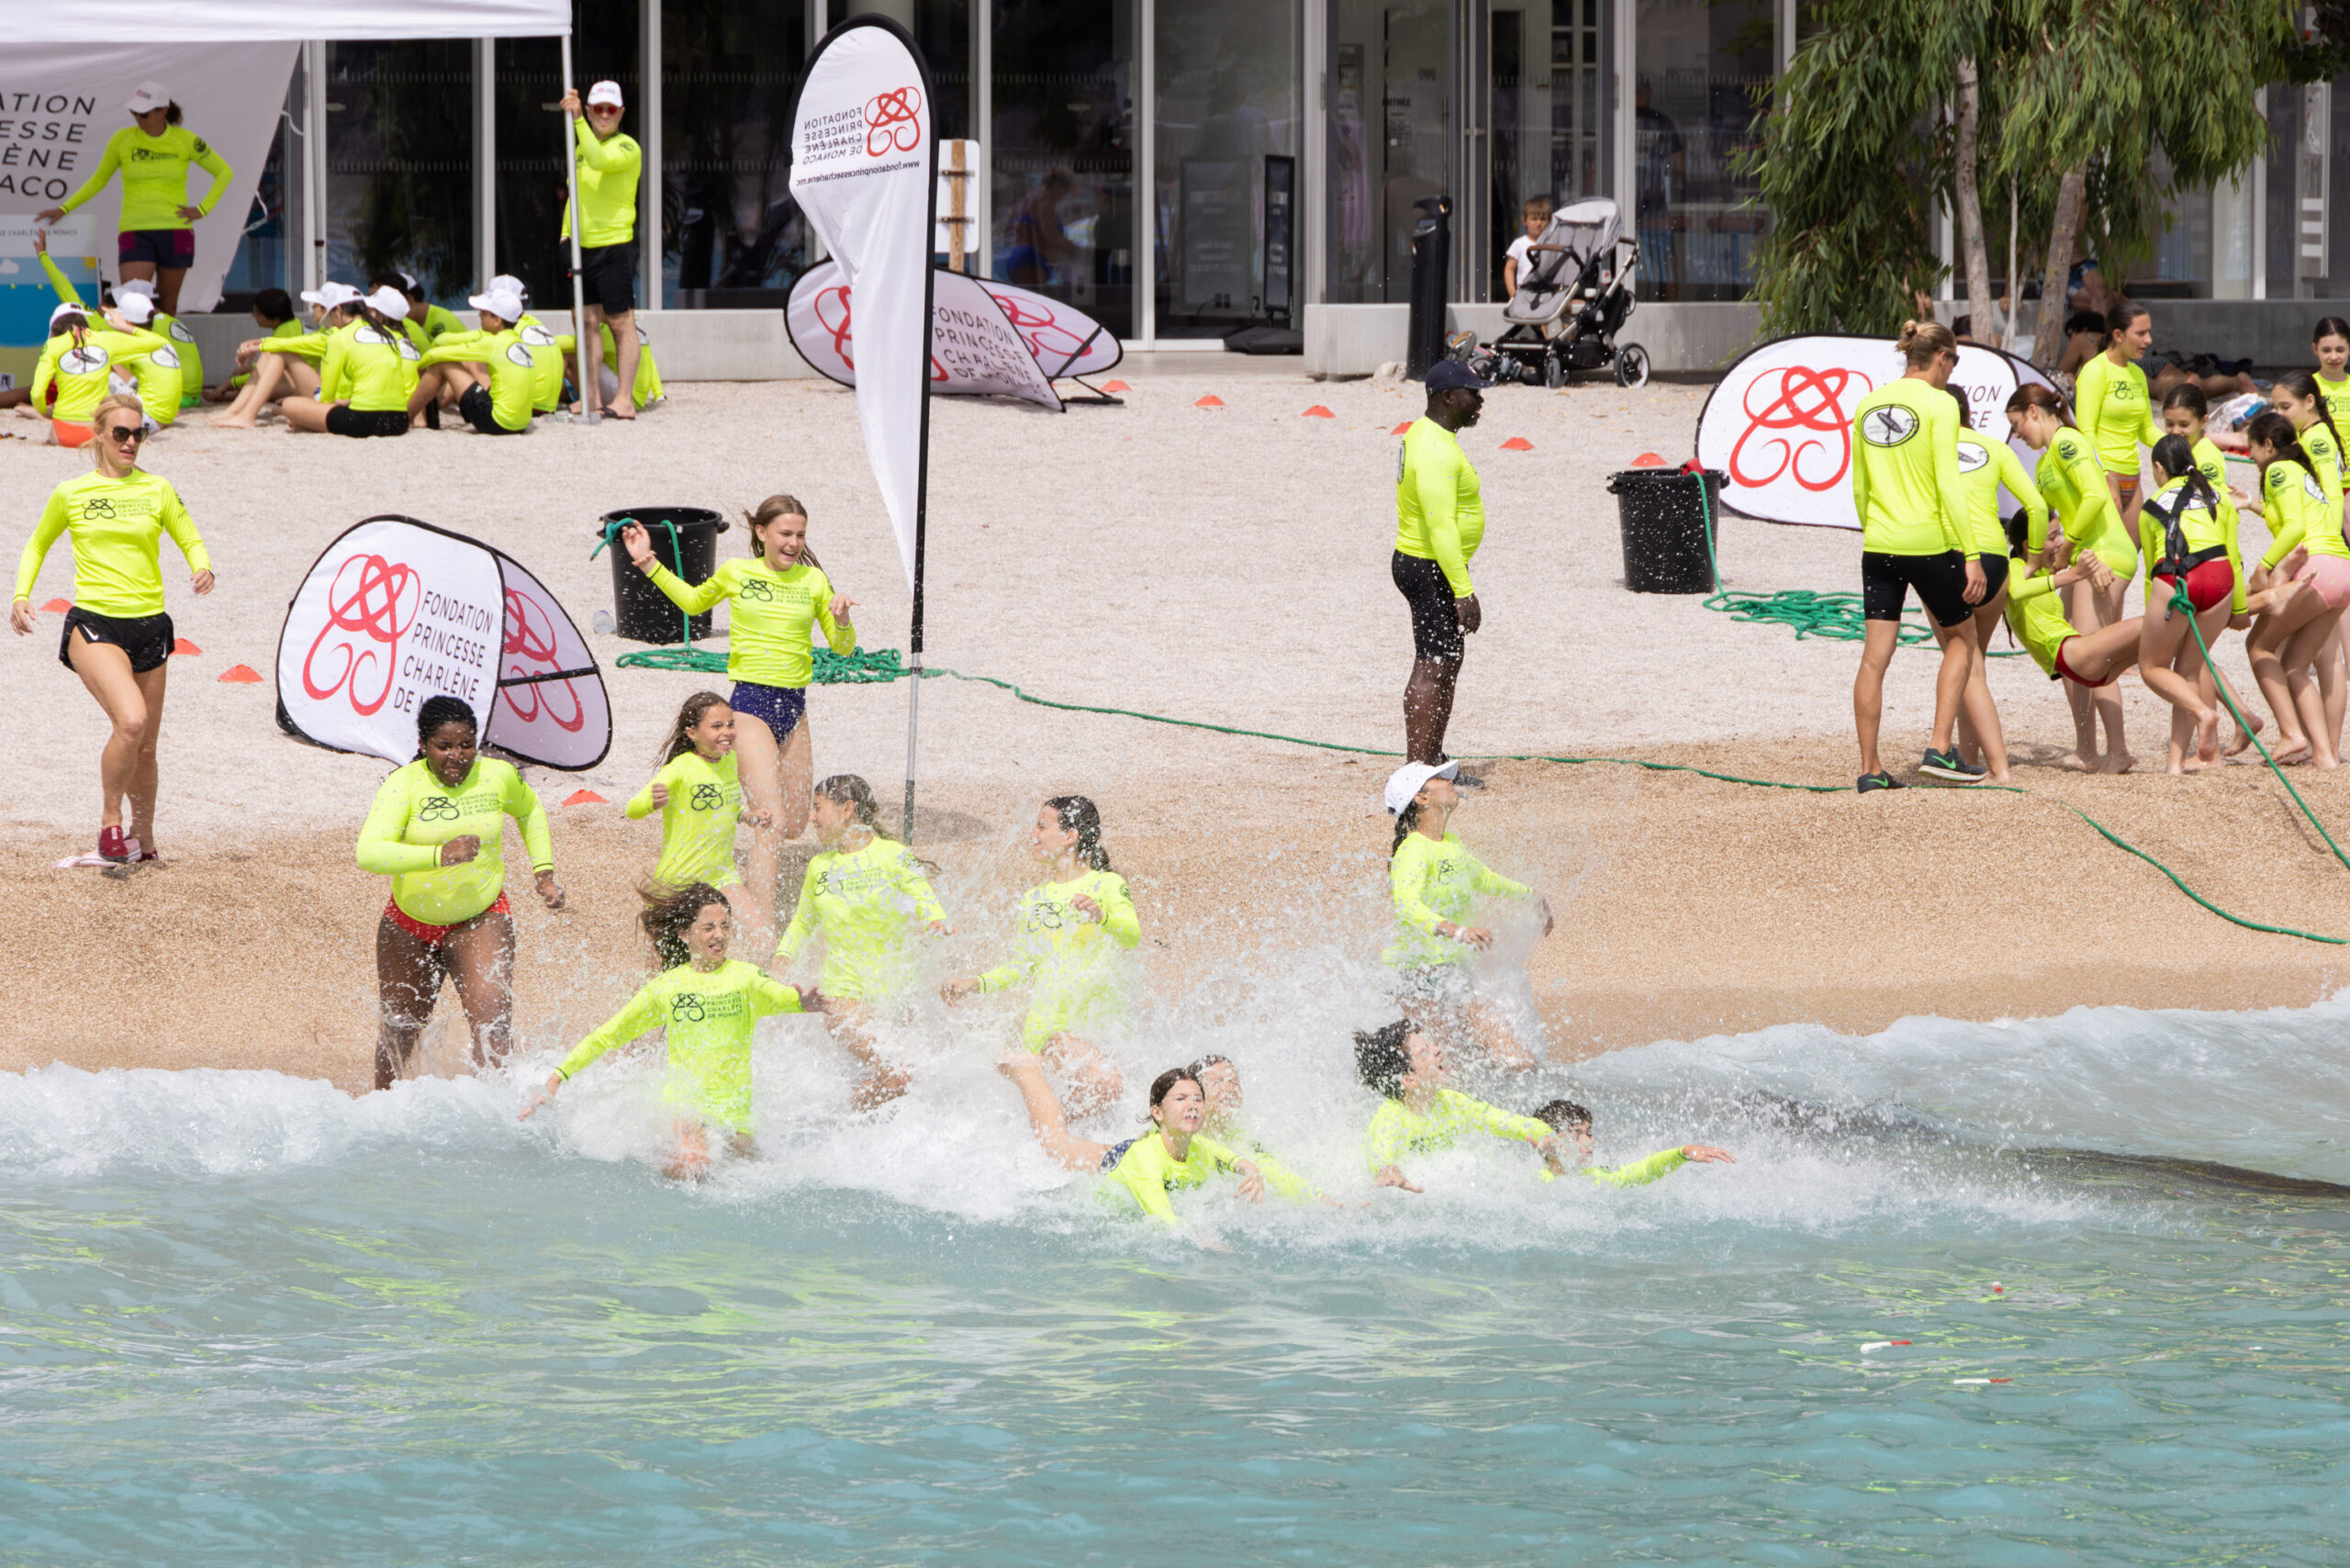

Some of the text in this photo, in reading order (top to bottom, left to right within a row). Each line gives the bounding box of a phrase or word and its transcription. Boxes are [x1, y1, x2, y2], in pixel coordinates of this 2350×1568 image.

[934, 327, 1026, 365] PRINCESSE
[953, 367, 981, 382] DE
[422, 590, 494, 635] FONDATION
[411, 622, 485, 668] PRINCESSE
[404, 655, 479, 701] CHARLÈNE
[394, 687, 415, 712] DE
